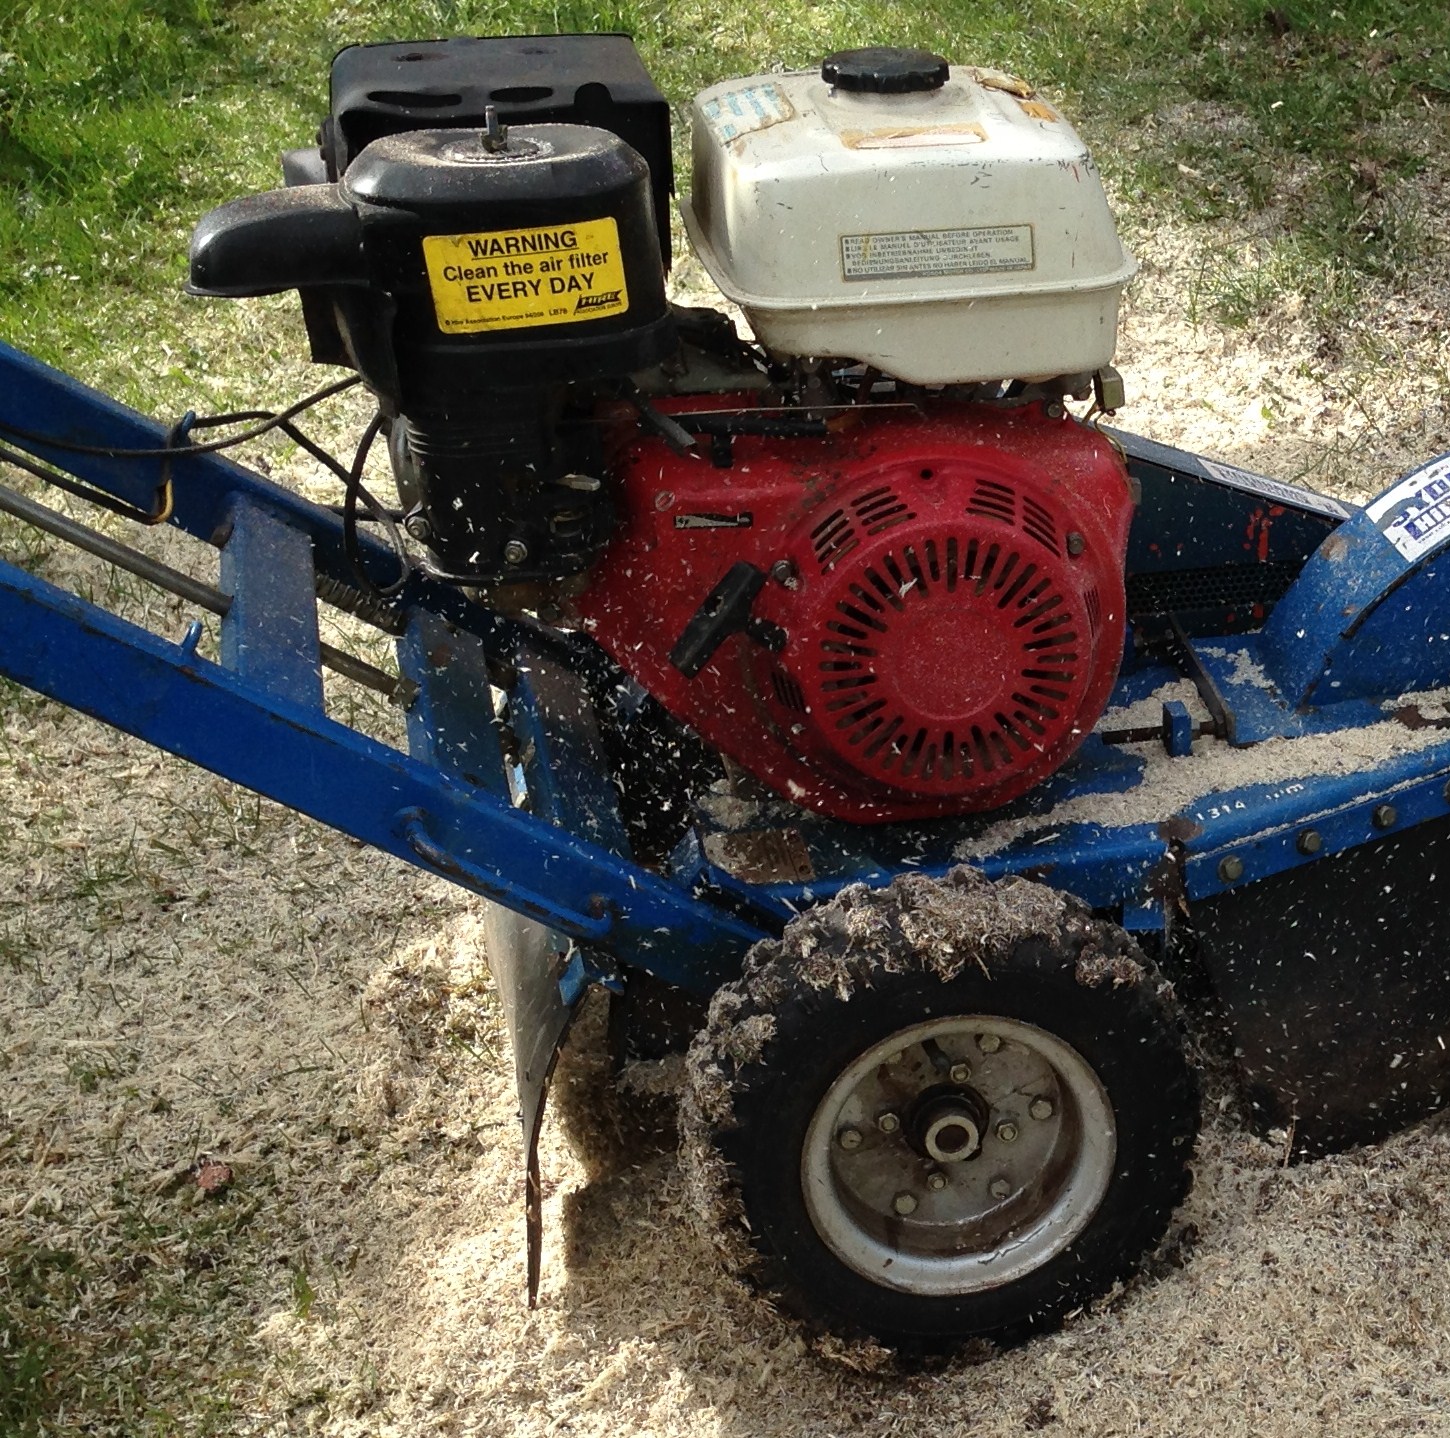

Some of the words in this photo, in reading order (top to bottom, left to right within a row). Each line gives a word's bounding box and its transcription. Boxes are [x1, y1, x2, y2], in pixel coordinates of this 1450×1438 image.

[468, 230, 577, 258] WARNING
[443, 265, 498, 282] Clean
[502, 260, 534, 276] the
[540, 256, 563, 273] air
[569, 251, 609, 269] filter
[466, 278, 541, 303] EVERY
[551, 272, 595, 295] DAY
